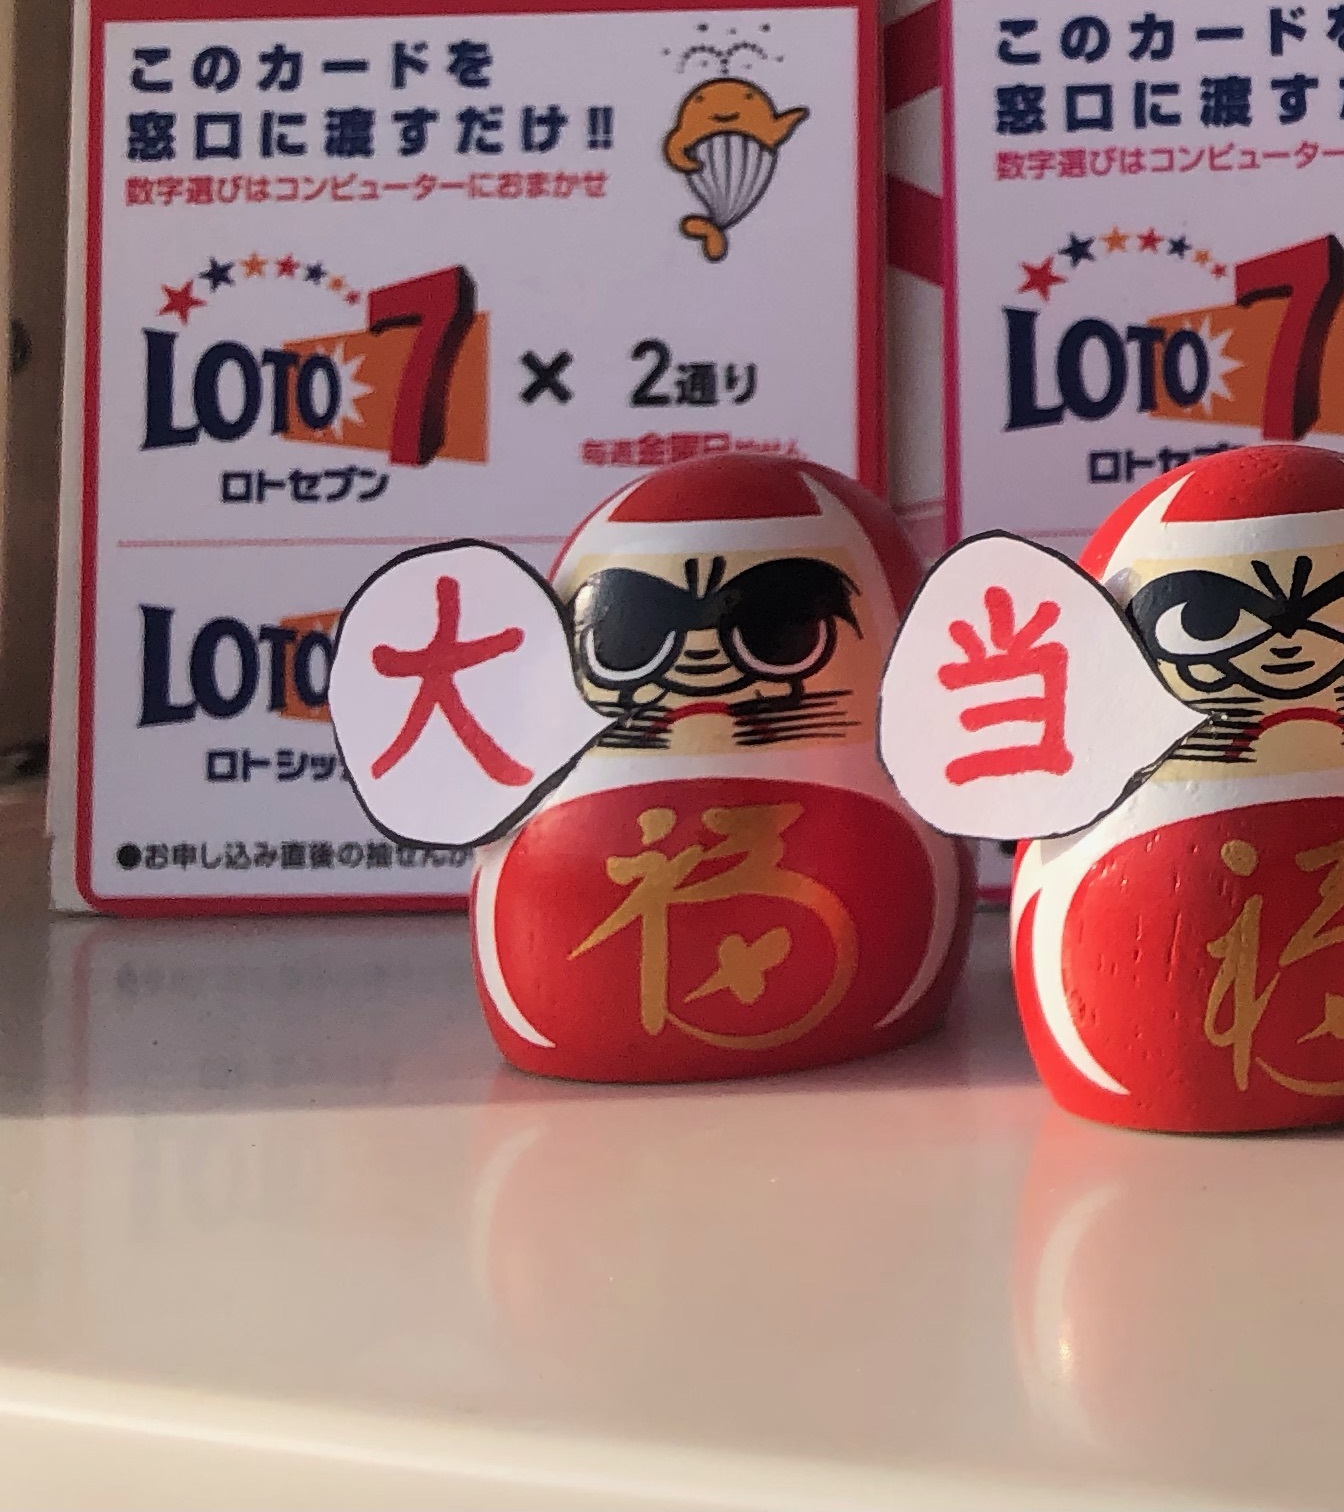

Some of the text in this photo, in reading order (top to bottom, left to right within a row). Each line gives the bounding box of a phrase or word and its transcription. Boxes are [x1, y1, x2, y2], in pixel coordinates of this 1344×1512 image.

[128, 40, 493, 92] このカードを
[125, 172, 608, 207] 数字選びはコンピューターにおまかせ
[140, 264, 477, 467] LOTO 7
[630, 339, 757, 408] 2通り
[1004, 306, 1211, 434] LOTO
[220, 470, 389, 504] ロトセブン
[138, 605, 333, 728] LOTO
[370, 575, 534, 788] 大
[937, 585, 1072, 785] 当
[206, 748, 350, 782] ロトシッ
